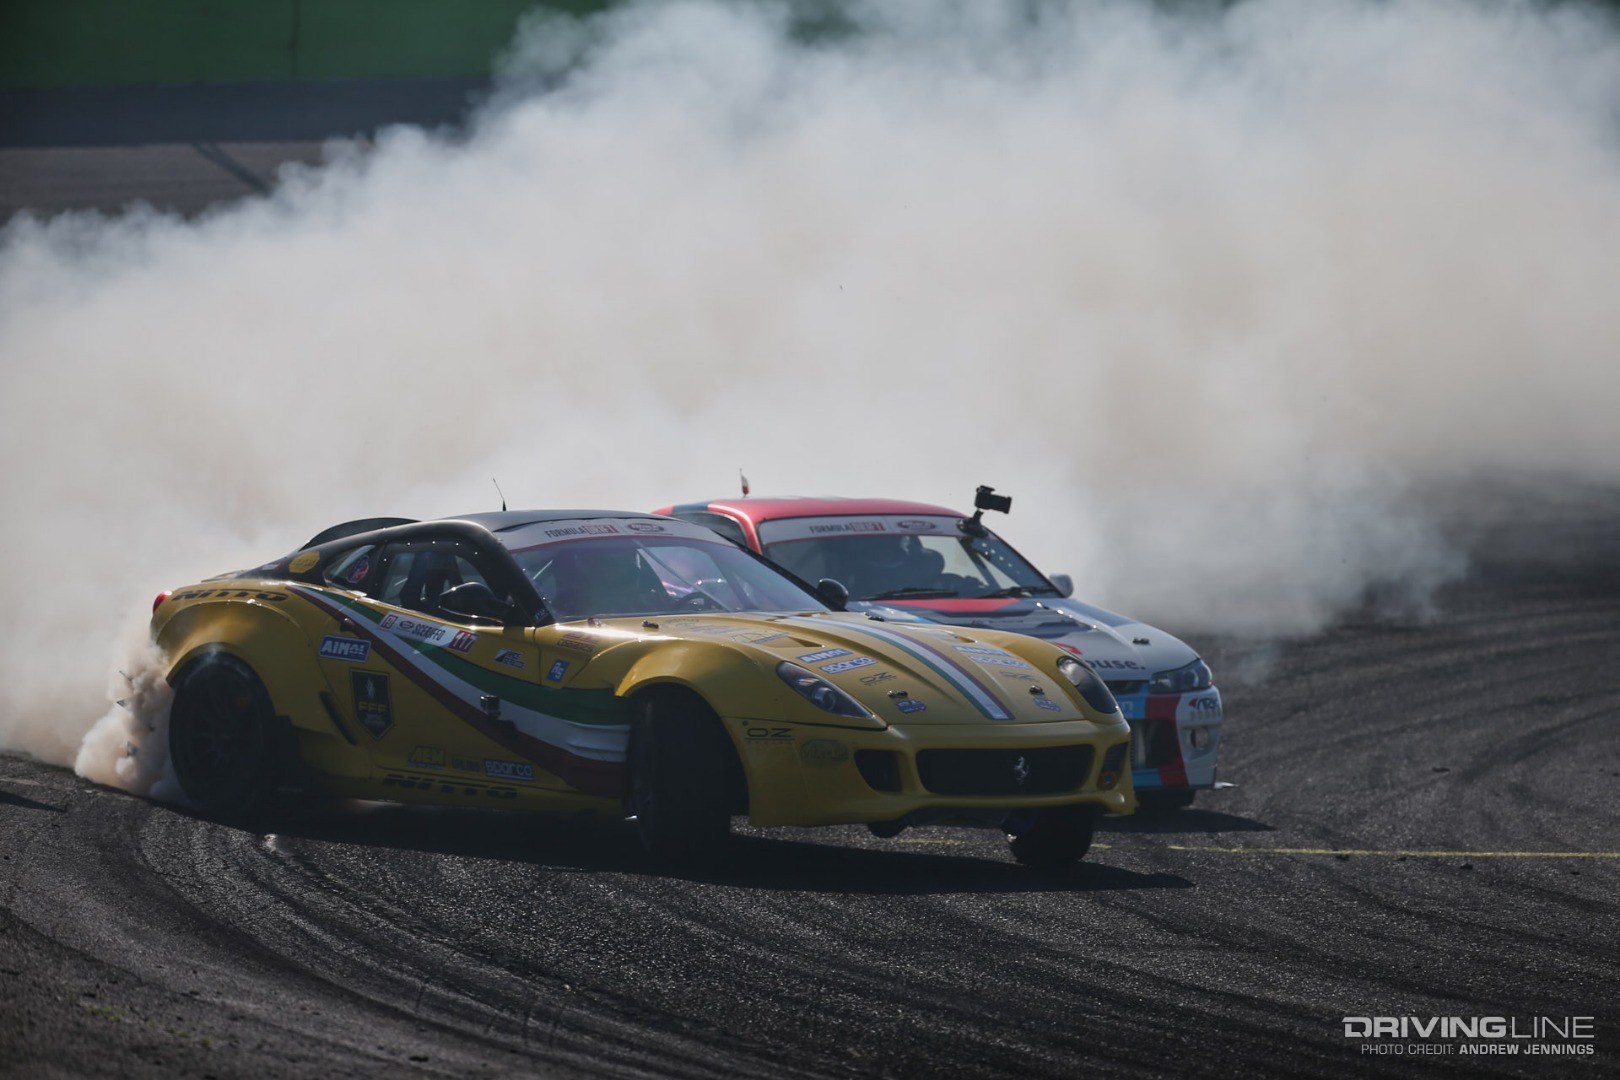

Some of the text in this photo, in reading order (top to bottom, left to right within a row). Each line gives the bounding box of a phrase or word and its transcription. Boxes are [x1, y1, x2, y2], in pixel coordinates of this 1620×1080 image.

[543, 526, 586, 538] FORMULA
[171, 588, 289, 602] NITTO
[452, 630, 478, 650] 117
[484, 759, 533, 777] sparco
[382, 773, 518, 799] NITTO
